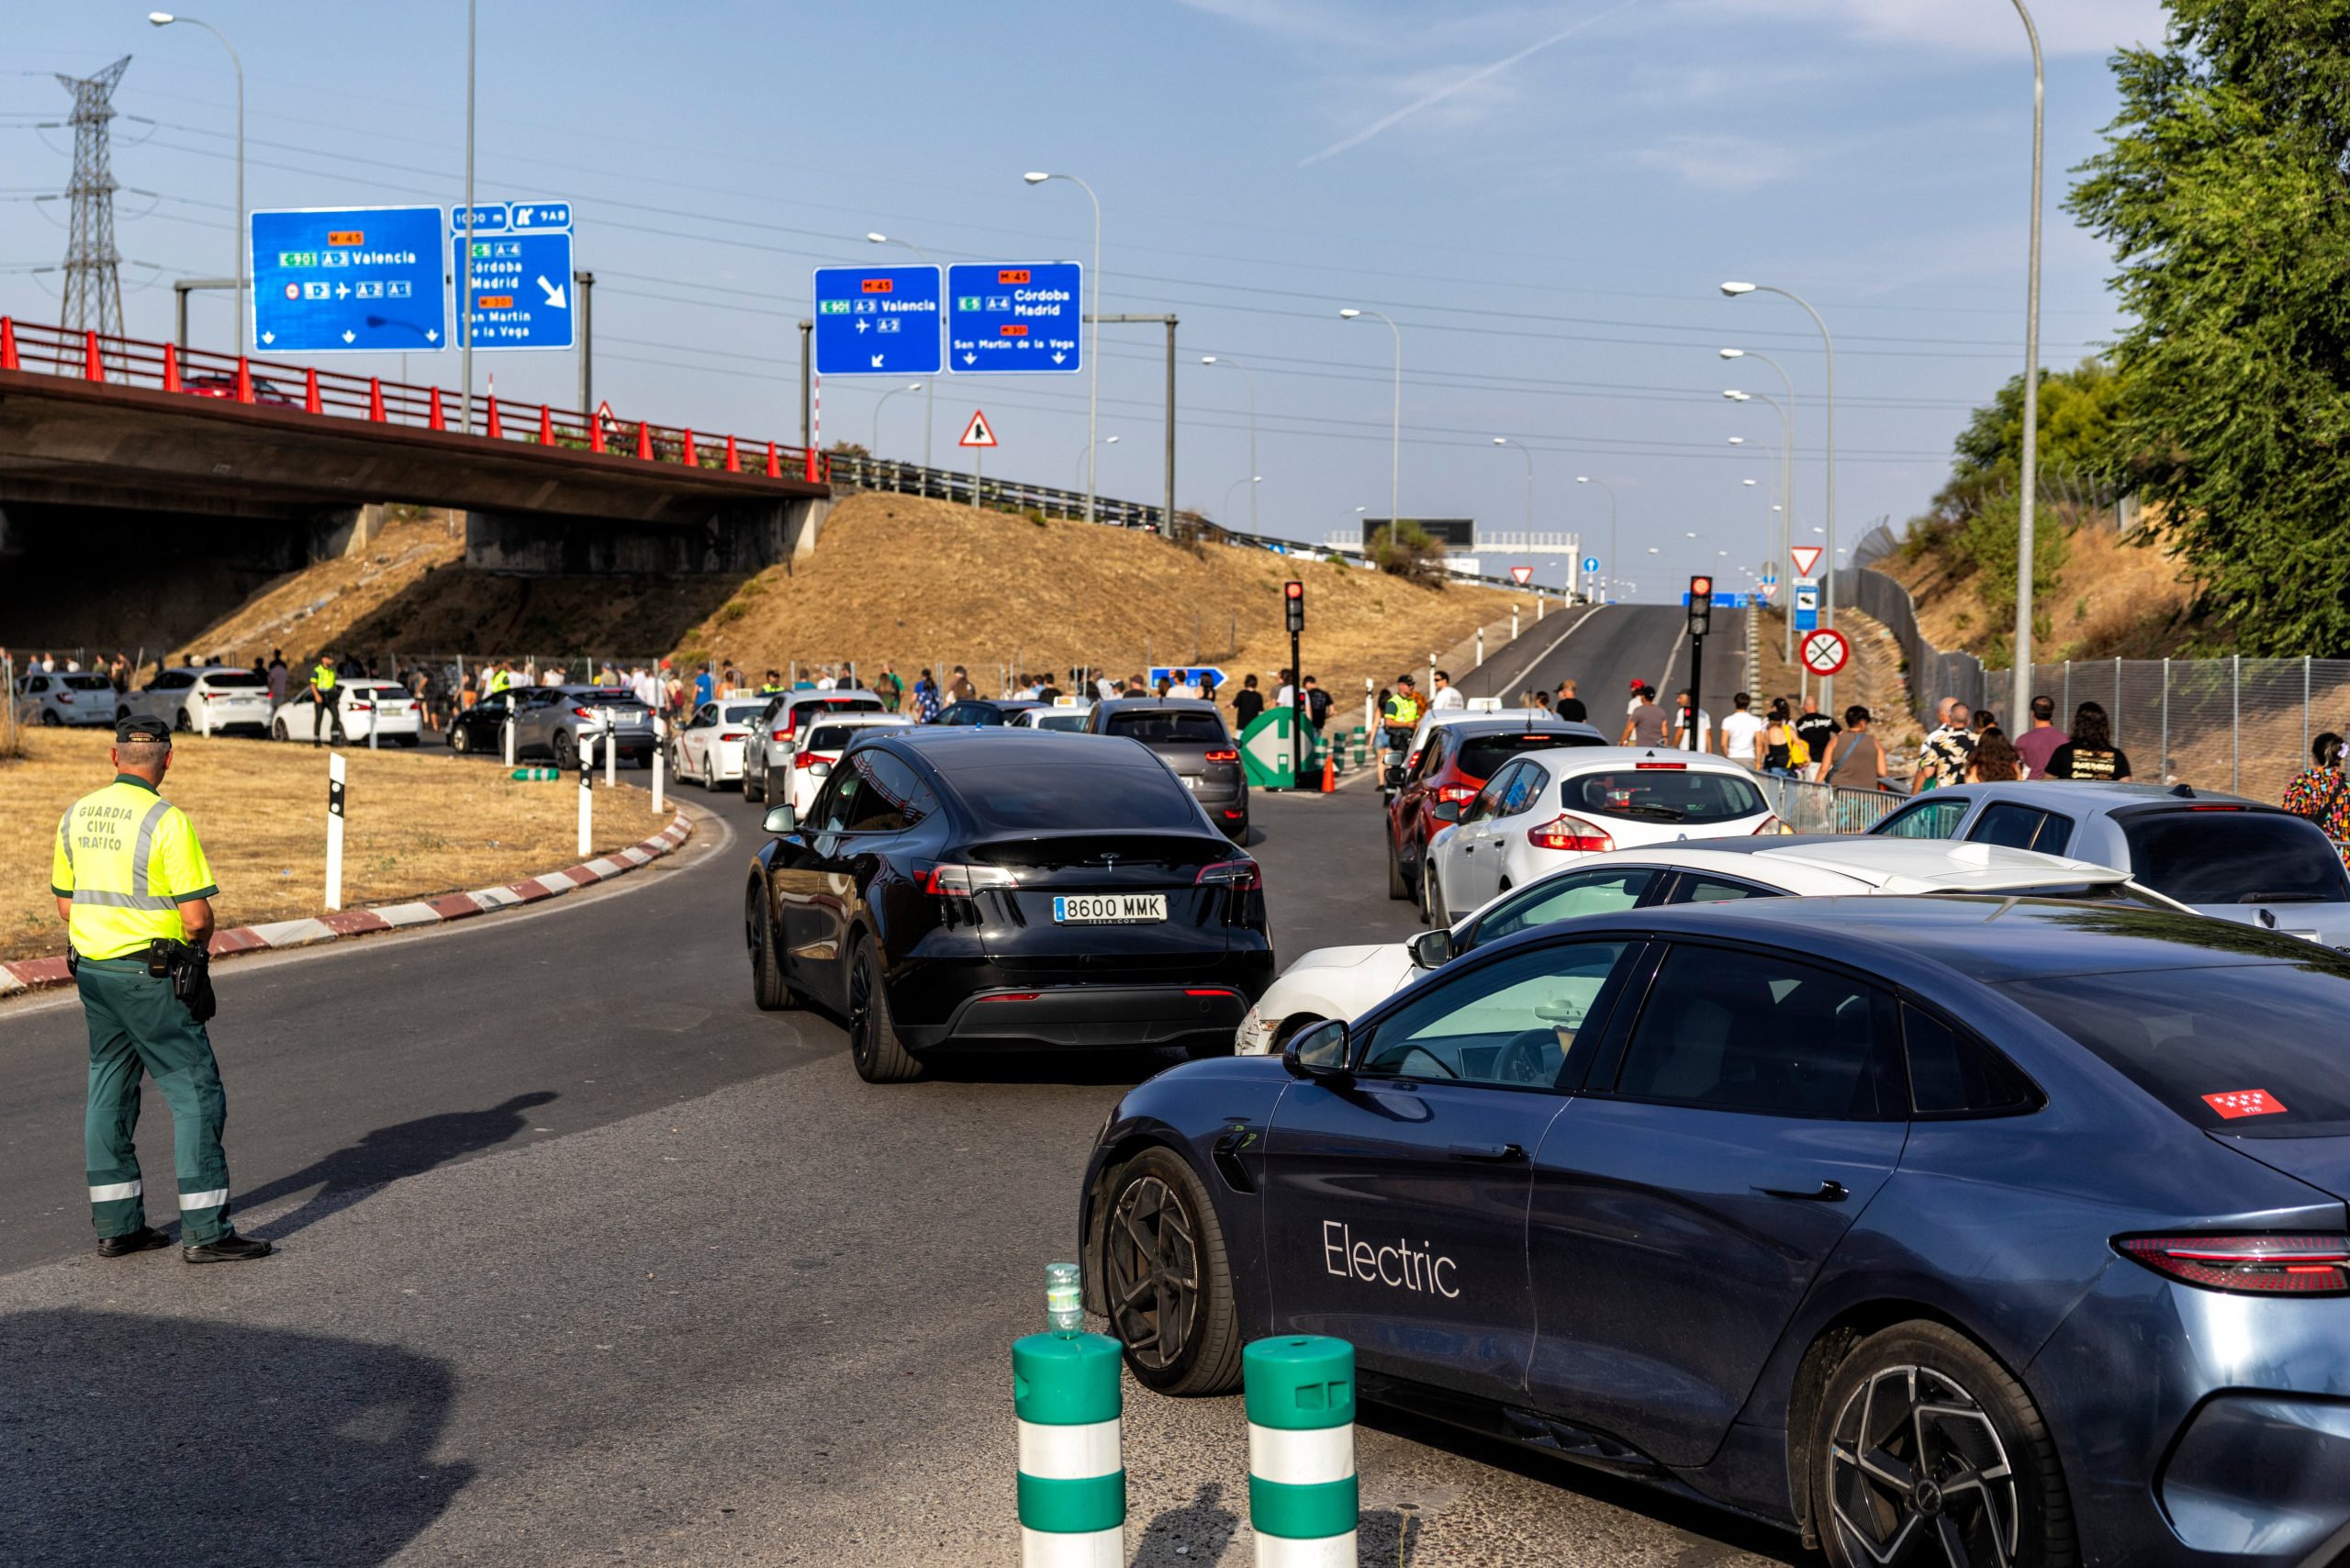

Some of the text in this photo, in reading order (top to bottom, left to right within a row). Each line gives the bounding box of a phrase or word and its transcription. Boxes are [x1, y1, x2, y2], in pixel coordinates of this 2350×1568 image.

[493, 214, 503, 222] m
[352, 250, 416, 264] Valencia
[471, 276, 519, 289] Madrid
[1014, 288, 1069, 301] Córdoba
[881, 298, 935, 312] Valencia
[989, 297, 1009, 308] A-4
[1014, 304, 1060, 316] Madrid
[484, 327, 495, 338] la
[499, 326, 530, 339] Vega
[954, 340, 974, 349] San
[1016, 339, 1030, 349] de
[1034, 339, 1045, 349] la
[1049, 339, 1075, 350] Vega
[79, 805, 133, 821] GUARDIA
[86, 820, 116, 834] CIVIL
[77, 836, 121, 851] TRAFICO
[1067, 898, 1160, 917] 8600 MMK
[1323, 1220, 1460, 1298] Electric
